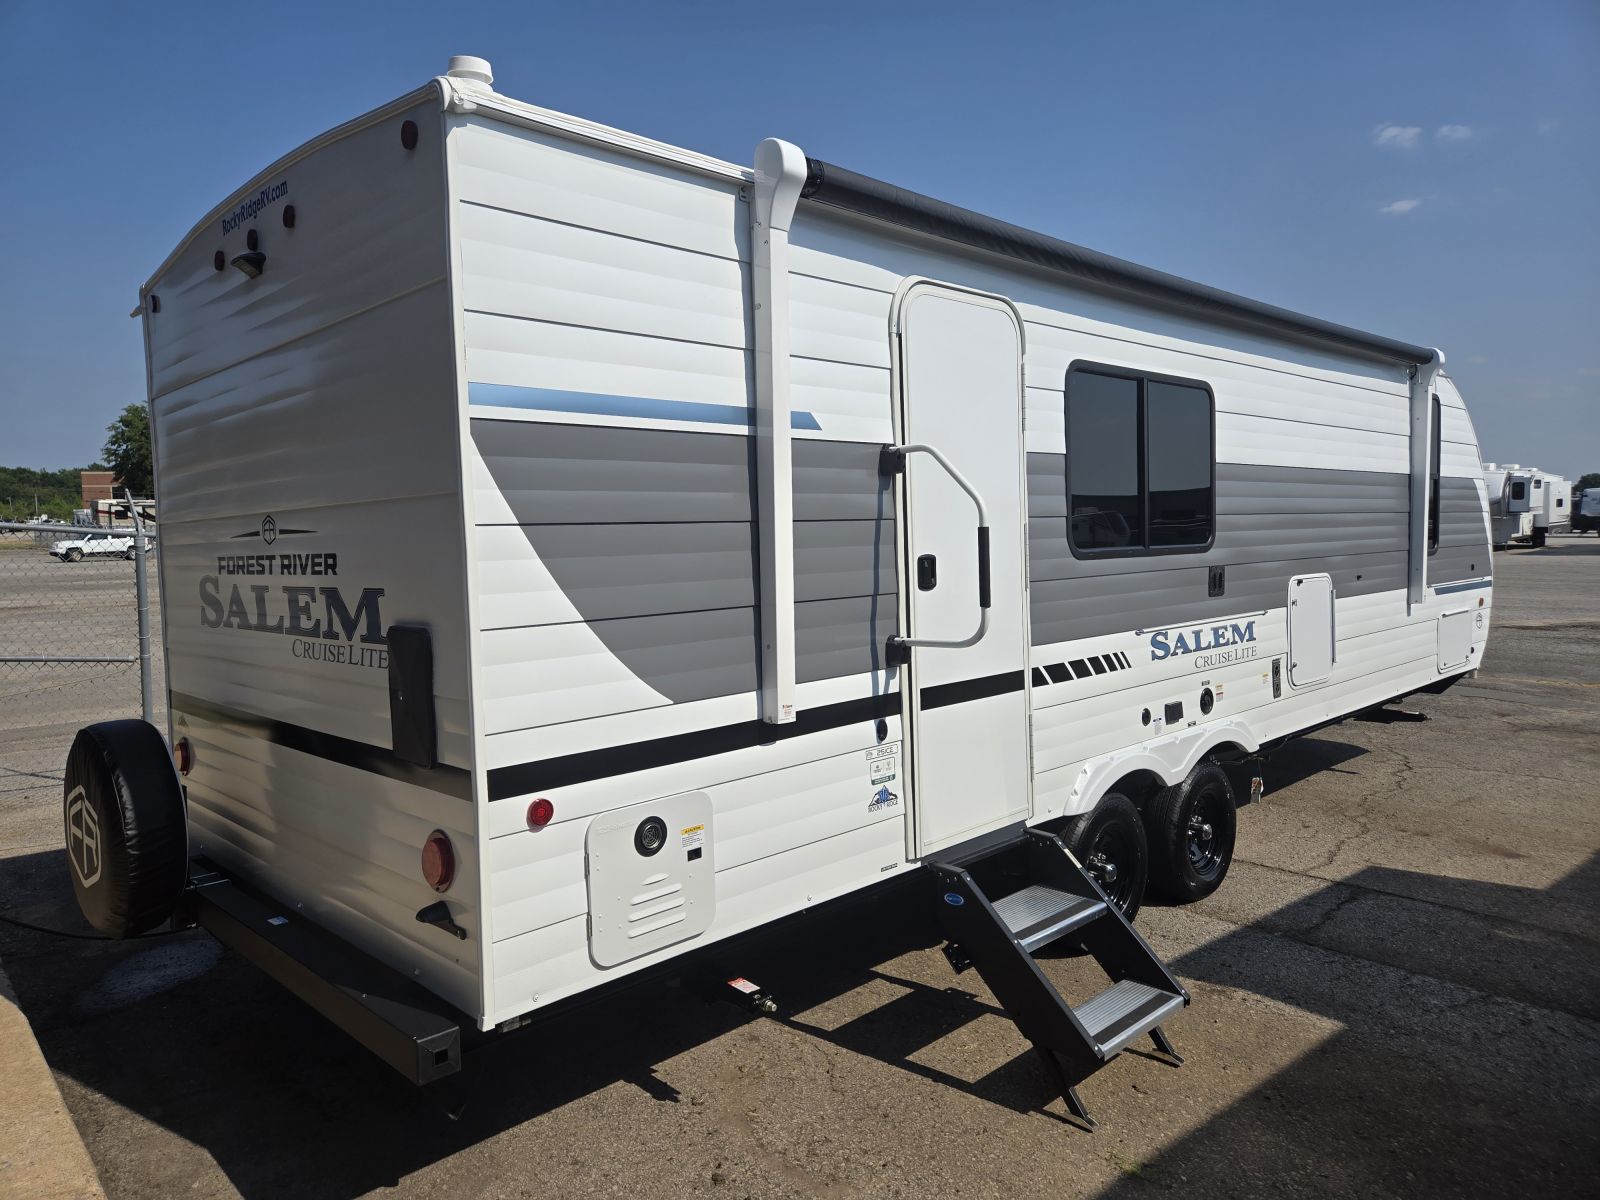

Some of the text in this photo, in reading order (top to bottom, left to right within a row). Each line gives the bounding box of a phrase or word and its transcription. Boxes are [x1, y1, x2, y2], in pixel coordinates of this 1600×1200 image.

[222, 180, 289, 236] RockyRidgeRV.com
[217, 553, 338, 576] FOREST RIVER
[199, 575, 389, 645] SALEM
[1151, 621, 1256, 660] SALEM
